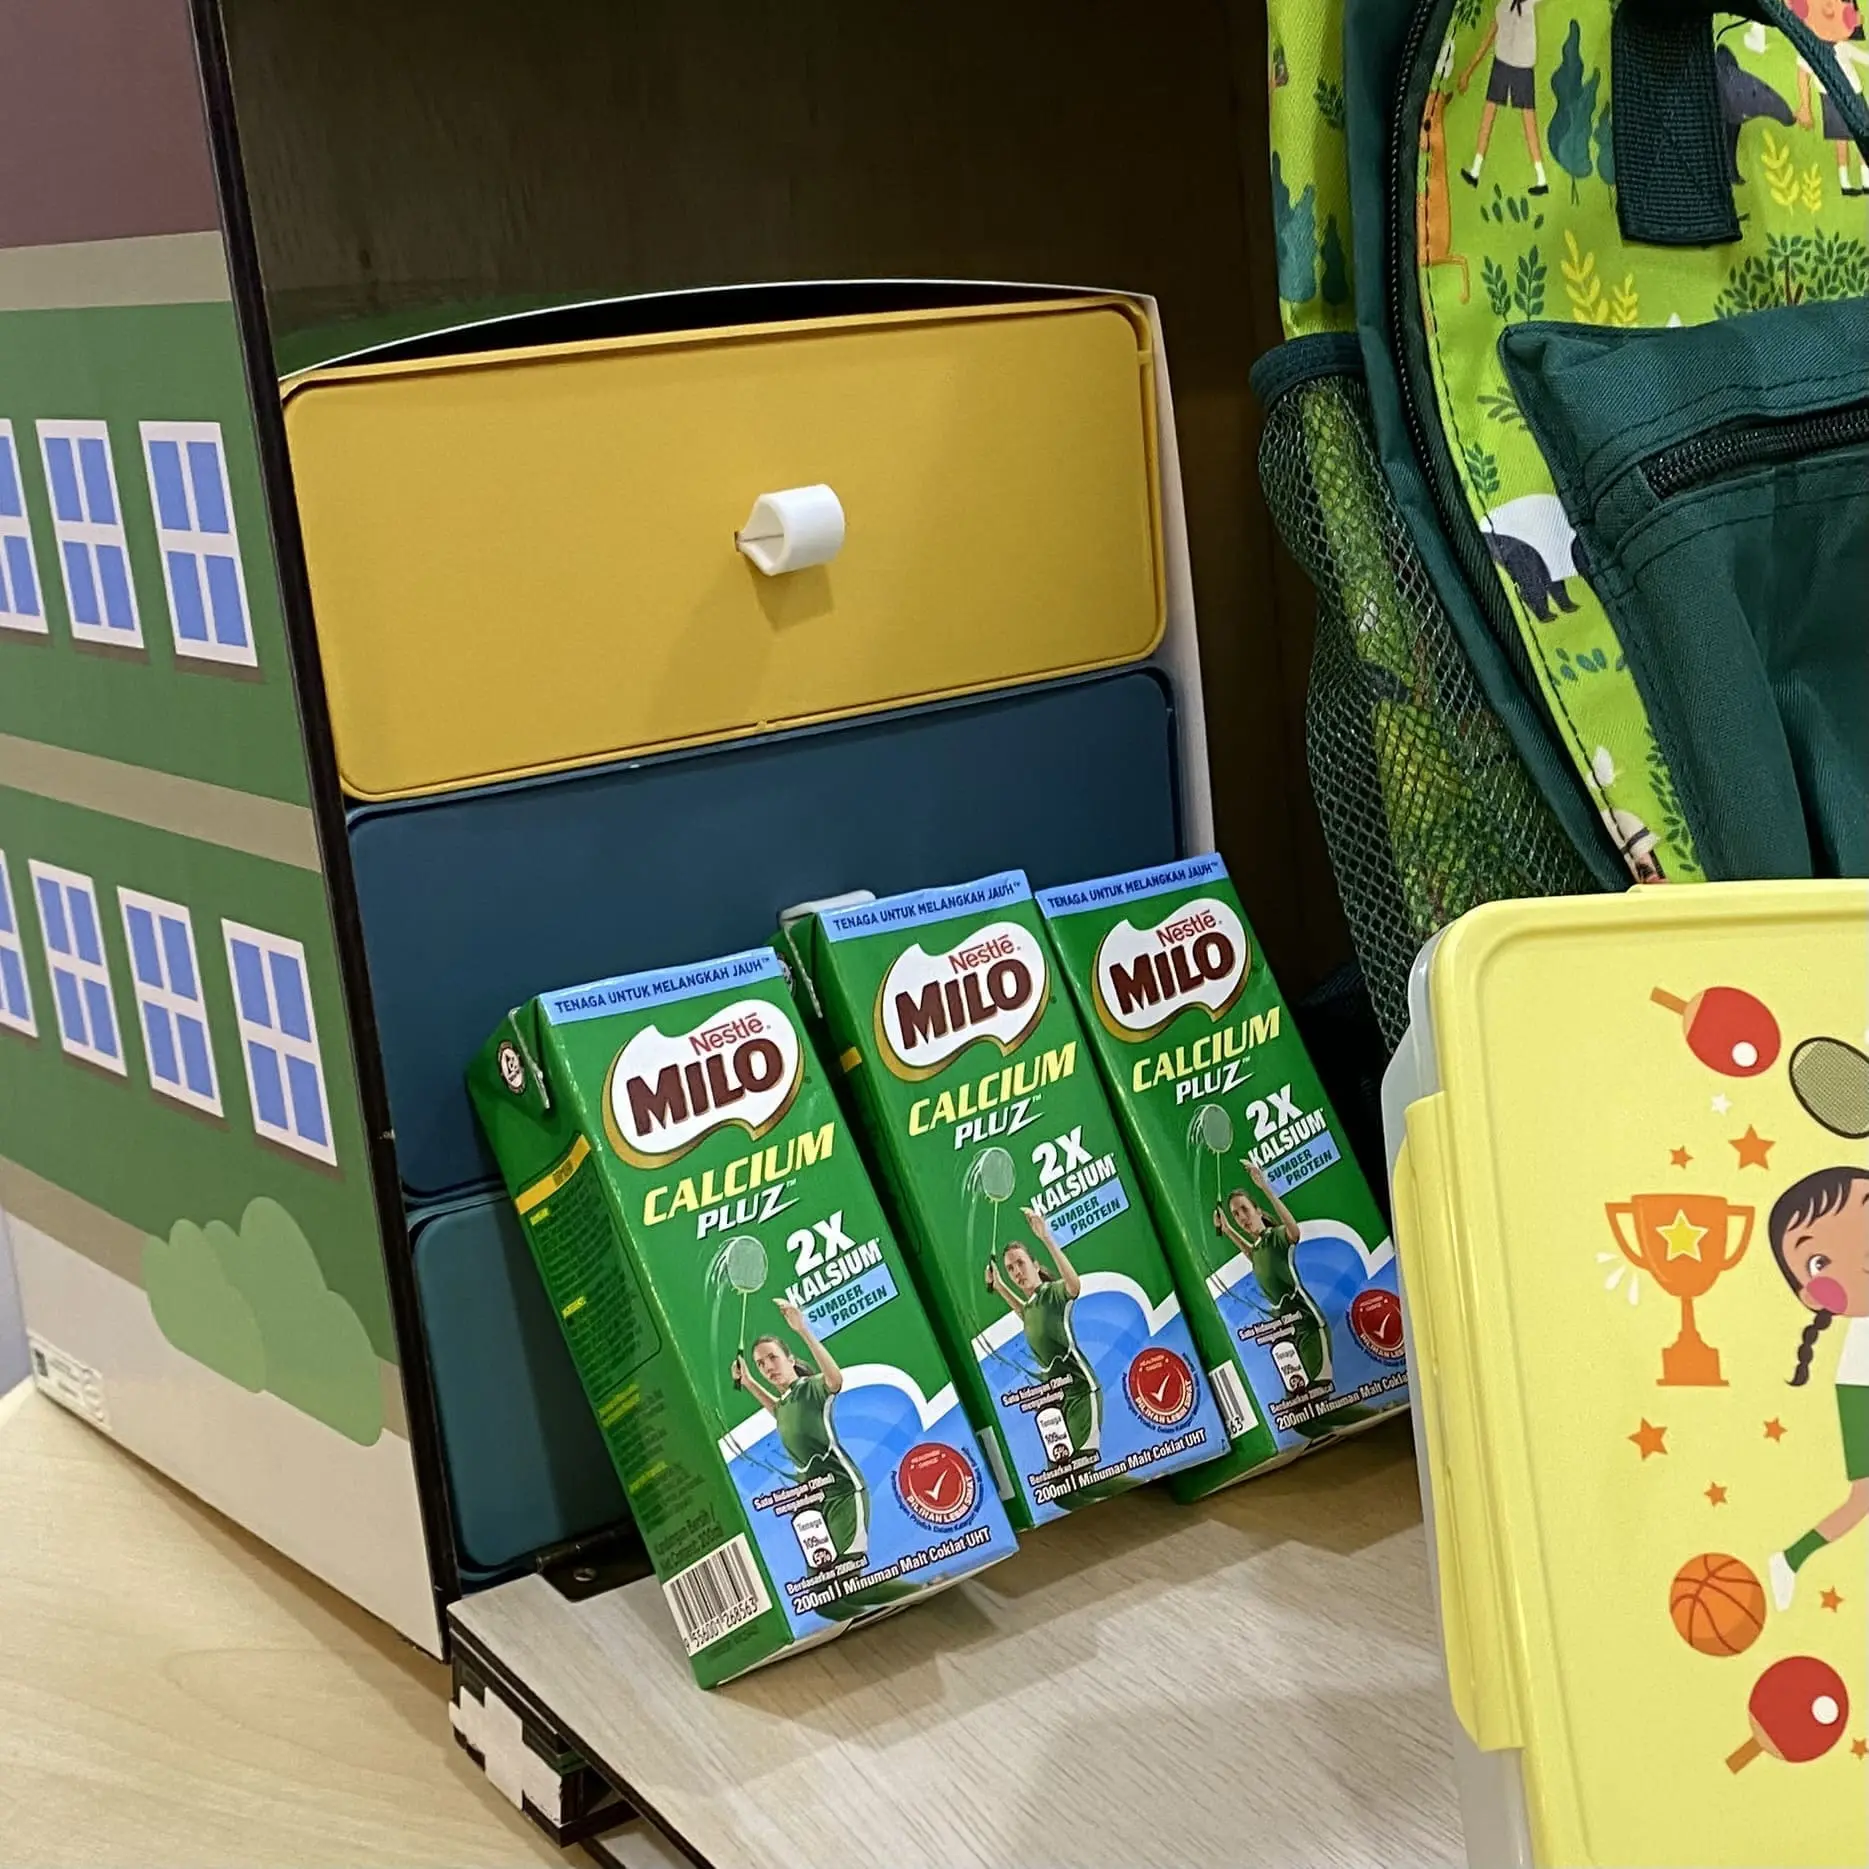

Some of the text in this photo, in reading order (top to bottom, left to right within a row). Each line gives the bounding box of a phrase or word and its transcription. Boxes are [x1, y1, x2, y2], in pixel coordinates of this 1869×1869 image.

[833, 913, 879, 931] TENAGA
[880, 904, 917, 923] UNTUK
[918, 890, 986, 915] MELANGKAH
[1047, 892, 1088, 909] TENAGA
[1089, 884, 1124, 902] UNTUK
[1125, 871, 1186, 893] MELANGKAH
[554, 994, 606, 1013] TENAGA
[608, 985, 650, 1005] UNTUK
[653, 967, 729, 996] MELANGKAH
[1109, 931, 1235, 1016] MILO
[895, 958, 1033, 1050] MILO
[1132, 1006, 1280, 1093] CALCIUM
[626, 1038, 784, 1136] MILO
[908, 1041, 1077, 1137] CALCIUM
[1246, 1084, 1303, 1141] 2X
[1032, 1125, 1093, 1187] 2X
[1248, 1108, 1327, 1167] KALSIUM
[1267, 1148, 1312, 1182] SUMBER
[1286, 1150, 1333, 1185] PROTEIN
[643, 1124, 836, 1226] CALCIUM
[1030, 1153, 1118, 1217] KALSIUM
[786, 1210, 858, 1277] 2X
[1050, 1196, 1100, 1232] SUMBER
[1071, 1198, 1121, 1236] PROTEIN
[785, 1239, 884, 1308] KALSIUM
[808, 1284, 864, 1323] SUMBER
[831, 1285, 888, 1326] PROTEIN
[1276, 1371, 1408, 1431] 200ml Minuman Malt Cokla
[1034, 1428, 1207, 1505] 200ml Minuman Malt Coklat UHT
[906, 1495, 942, 1523] PILIHAN
[794, 1526, 991, 1614] 200ml Minuman Malt Coklat UHT
